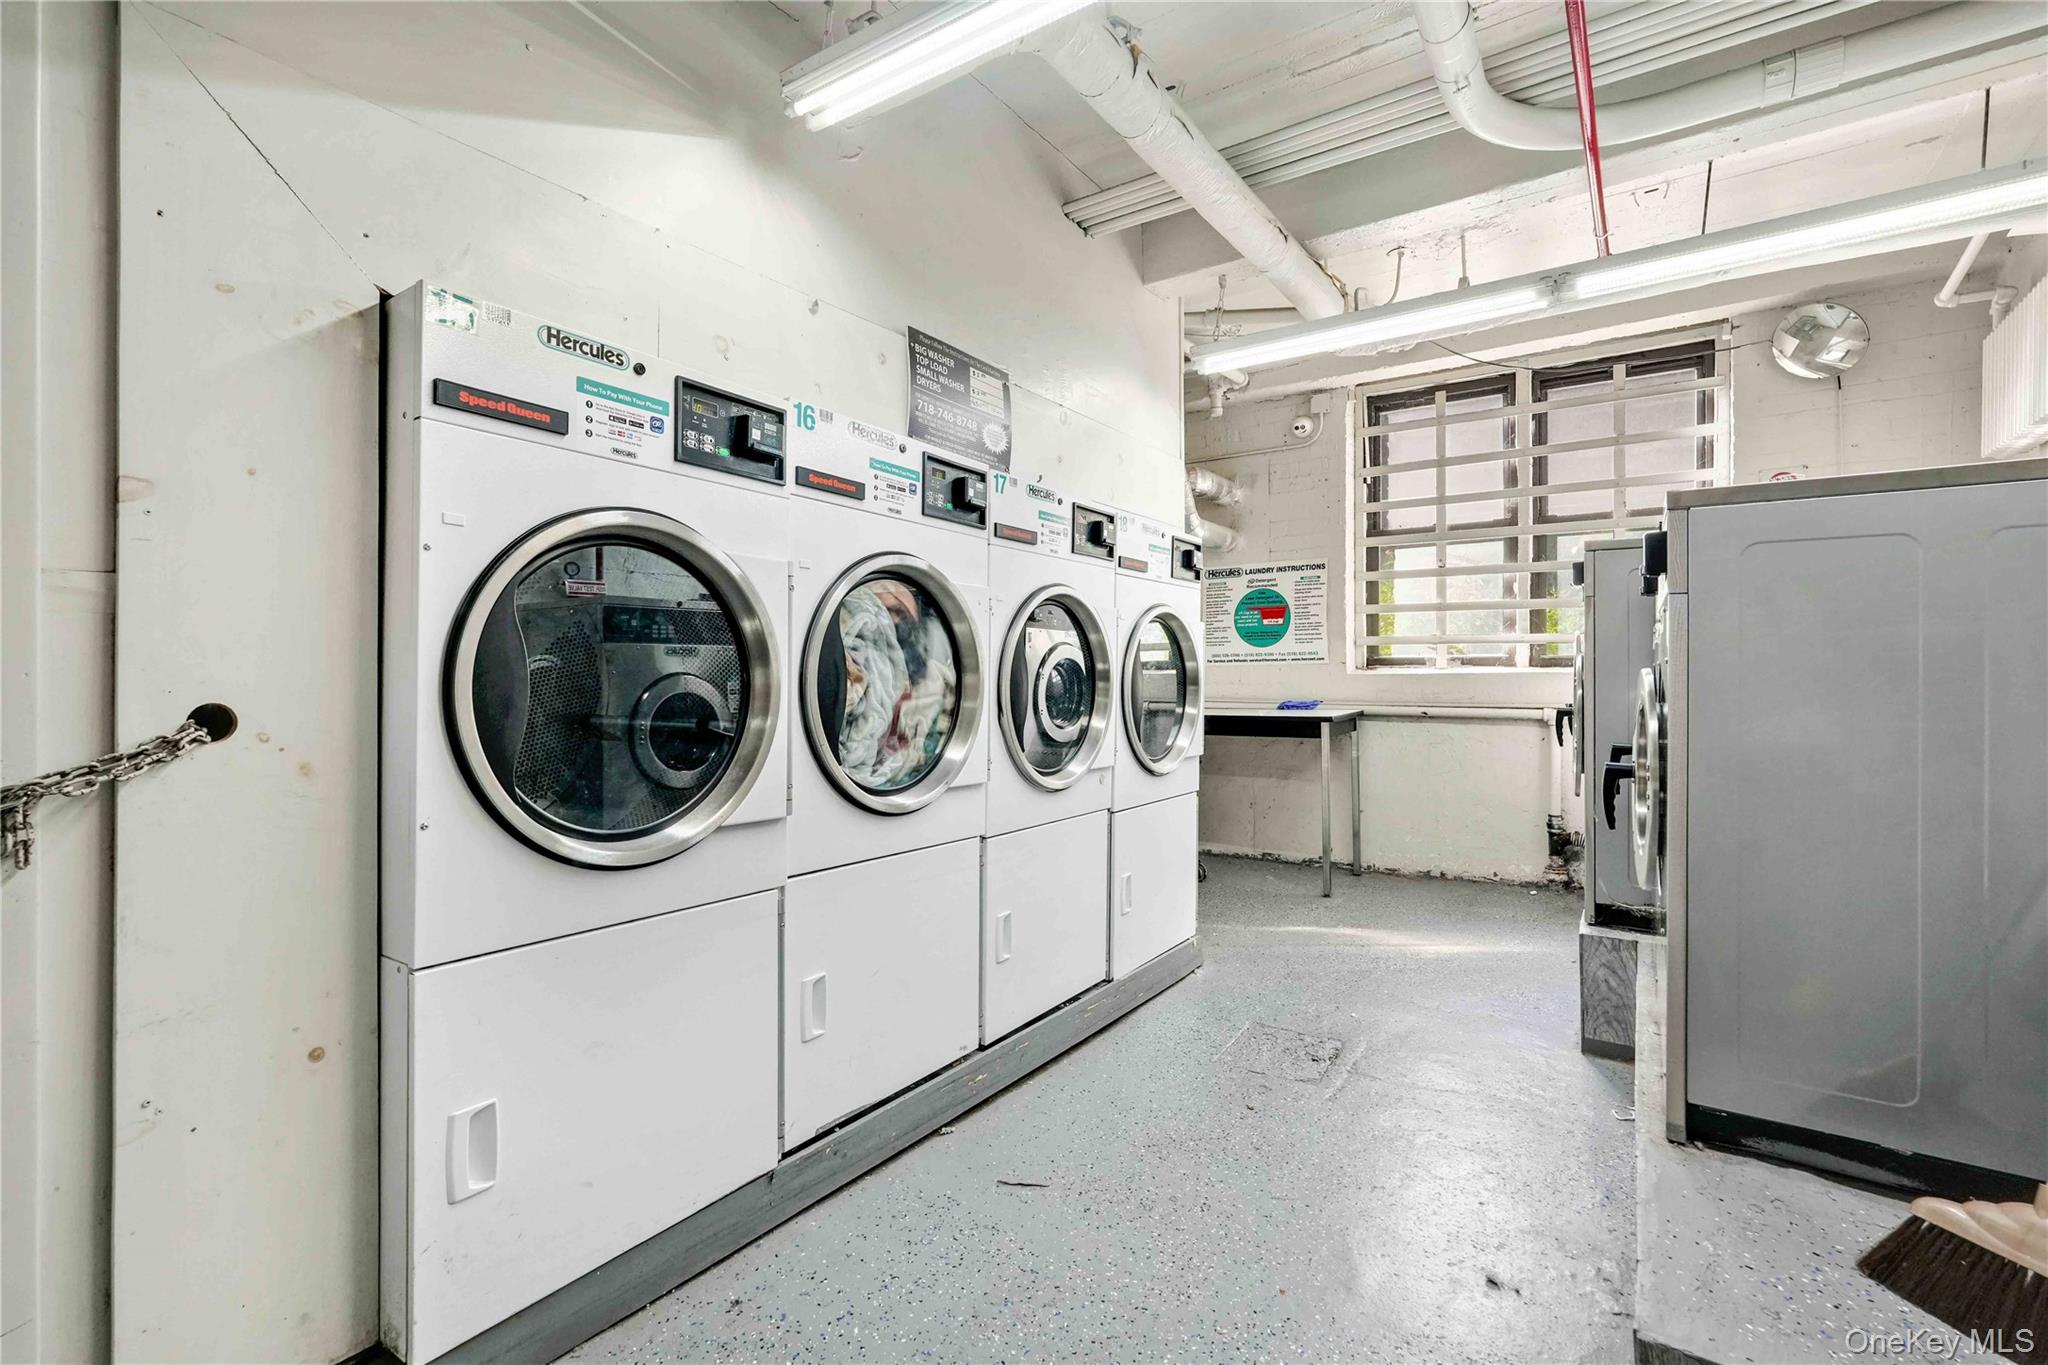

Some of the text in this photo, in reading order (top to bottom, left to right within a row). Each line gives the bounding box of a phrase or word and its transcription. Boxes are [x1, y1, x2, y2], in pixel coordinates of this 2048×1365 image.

[546, 326, 624, 366] Hercules
[914, 343, 955, 368] BIG WASHER
[916, 354, 948, 375] TOP LOAD
[916, 364, 938, 381] SMALL
[938, 373, 965, 393] WASHER
[916, 375, 942, 392] DRYERS
[458, 390, 551, 423] Speed Queen
[583, 384, 598, 392] How
[606, 390, 618, 399] Pay
[618, 393, 632, 402] With
[632, 397, 645, 406] Your
[646, 401, 663, 410] Phone
[793, 402, 816, 431] 16
[851, 422, 896, 448] Hercules
[612, 447, 637, 459] Hercules
[808, 473, 856, 492] Speed Queen
[994, 473, 1007, 494] 17
[1028, 484, 1055, 502] Hercules
[1208, 563, 1326, 578] Hercules LAUNDRY INSTRUCTIONS
